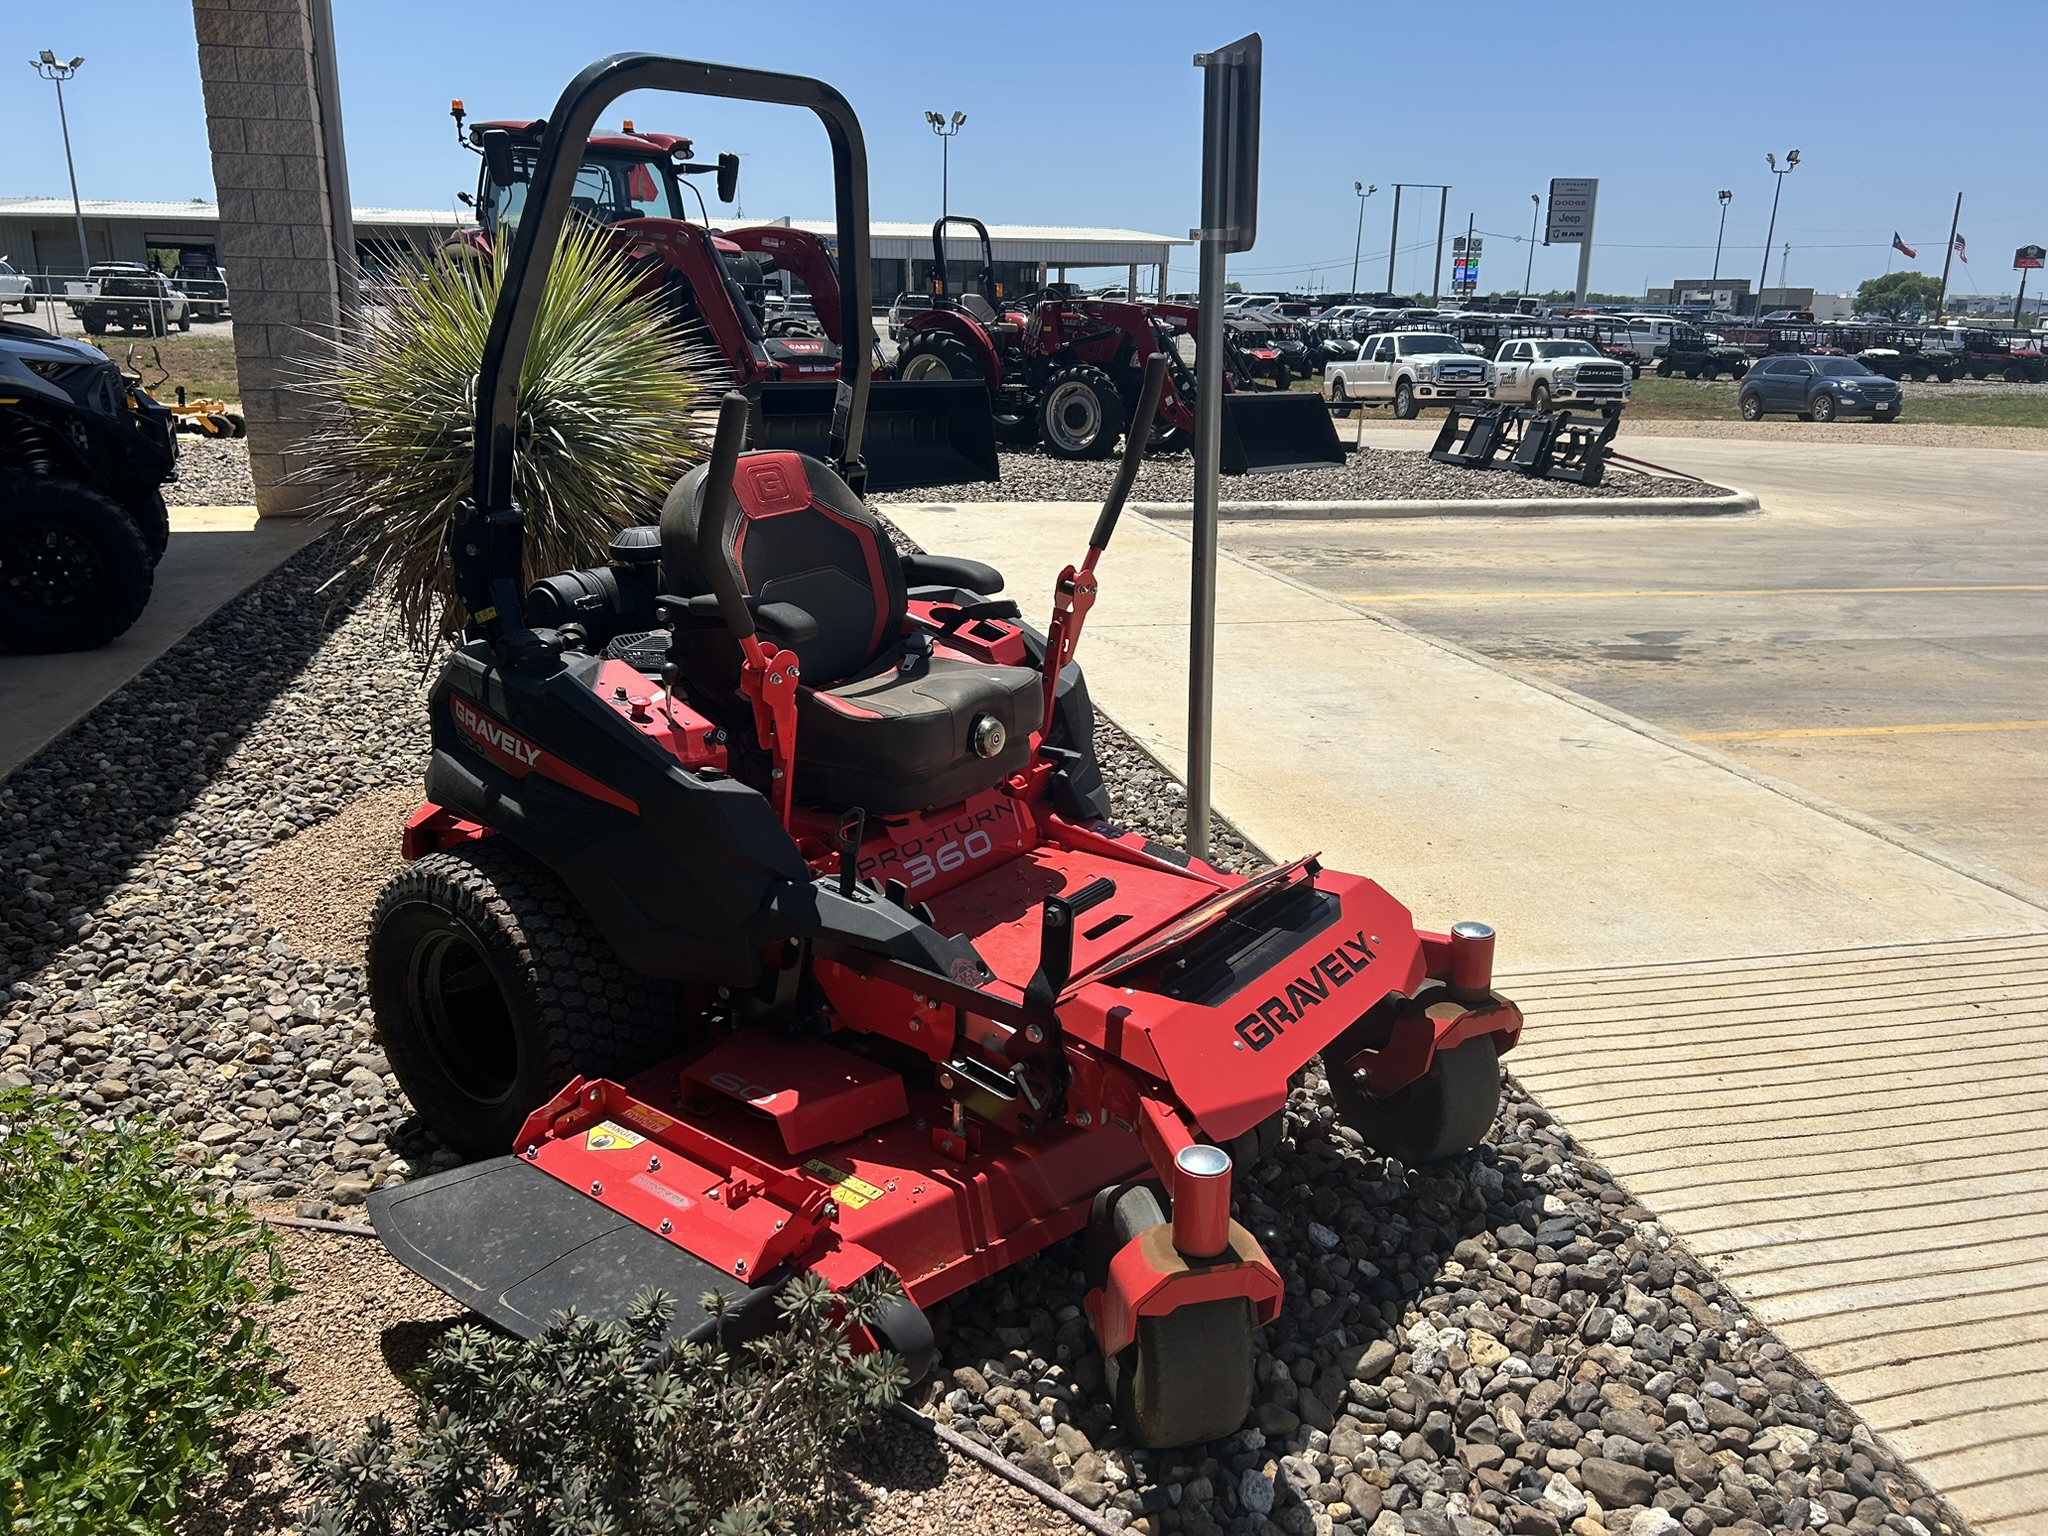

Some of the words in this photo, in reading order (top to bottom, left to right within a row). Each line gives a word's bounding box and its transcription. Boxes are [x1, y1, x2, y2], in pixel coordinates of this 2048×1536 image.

[1558, 213, 1581, 224] Jeep
[455, 699, 541, 766] GRAVELY
[855, 799, 1015, 879] PRO-TURN
[903, 829, 992, 888] 360
[1234, 930, 1377, 1052] GRAVELY
[709, 1072, 777, 1104] 60
[603, 1121, 640, 1142] DANGER
